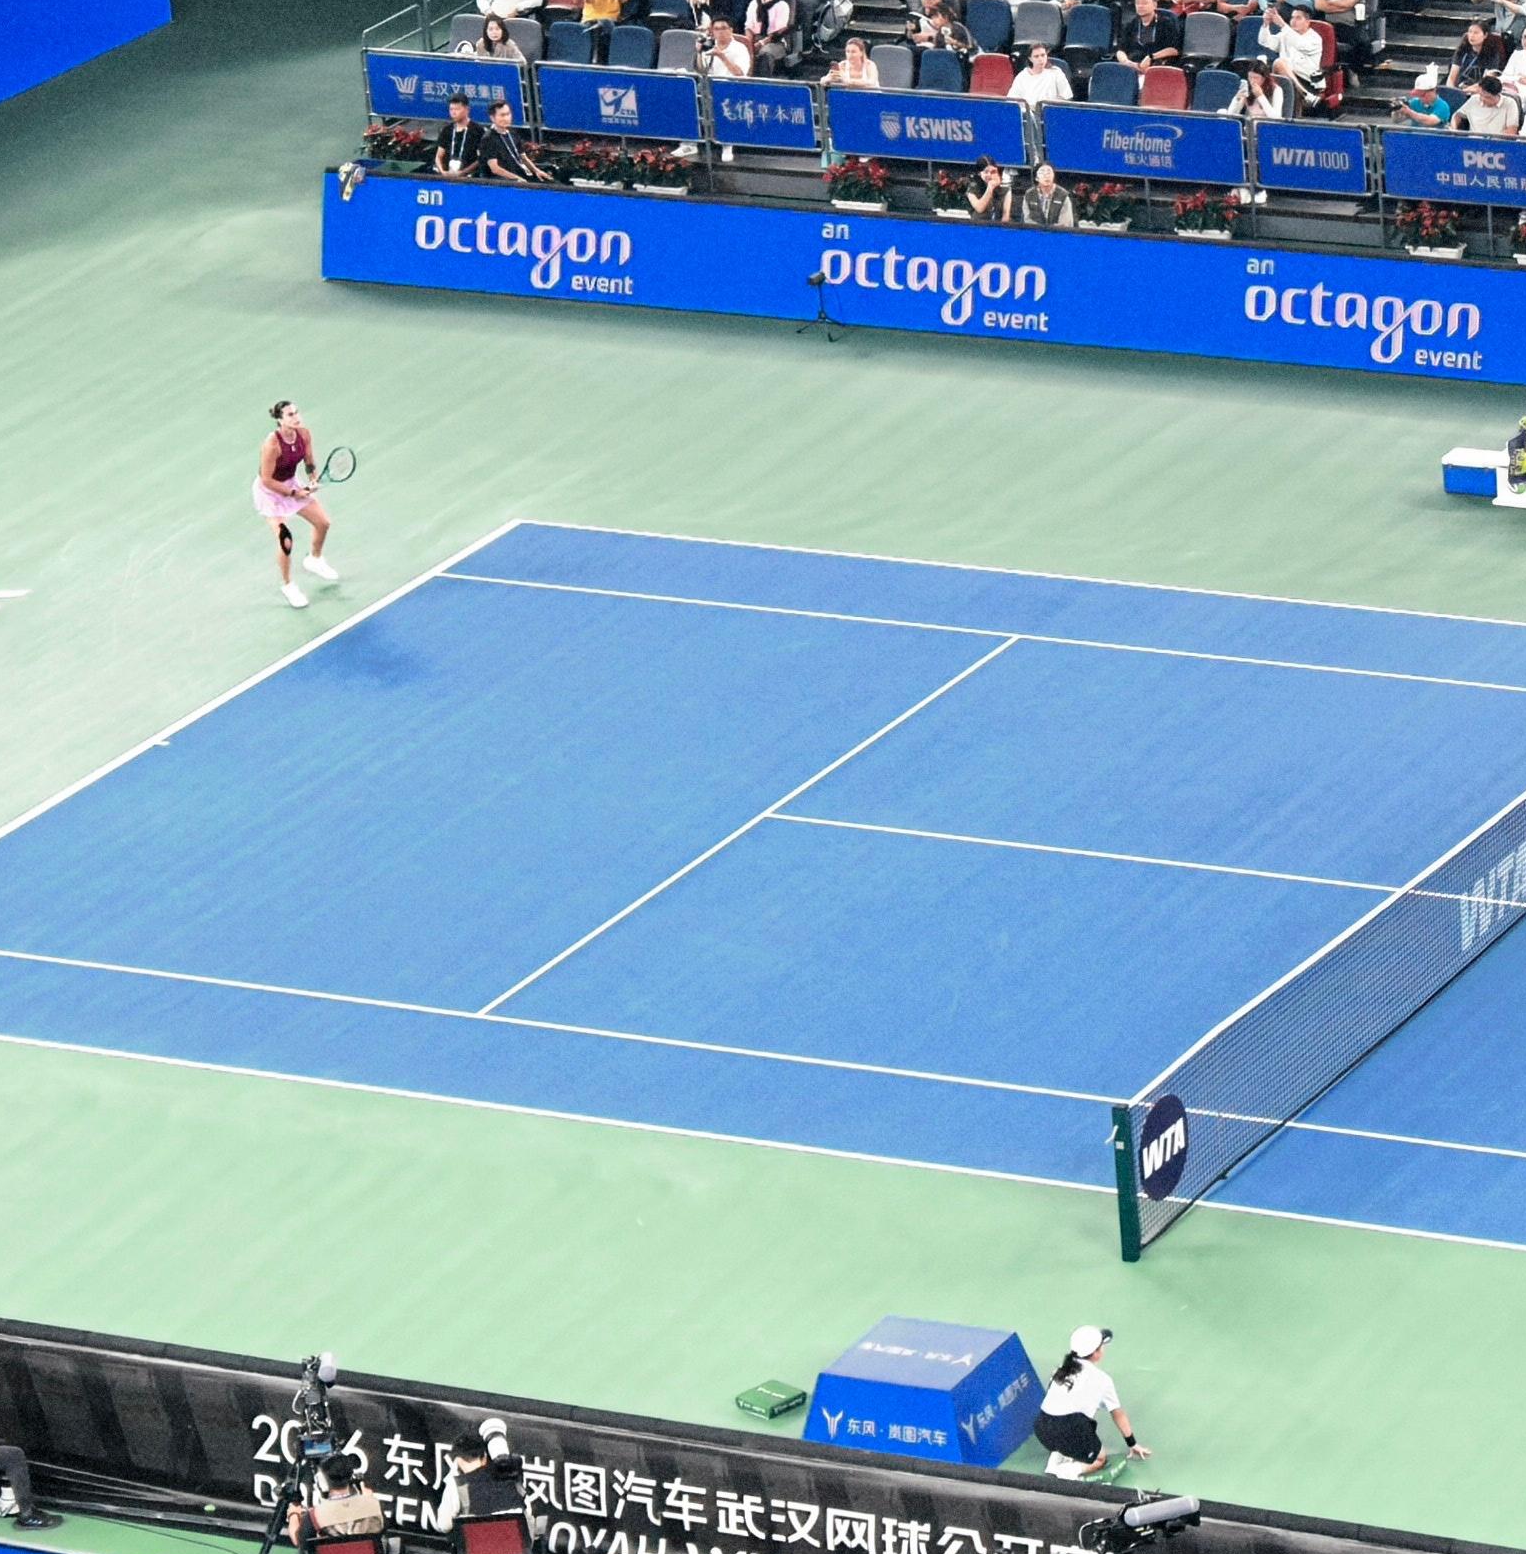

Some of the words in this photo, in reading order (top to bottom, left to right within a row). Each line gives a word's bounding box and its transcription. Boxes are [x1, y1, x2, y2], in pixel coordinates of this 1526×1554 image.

[1102, 129, 1172, 153] FiberHome
[1463, 150, 1506, 171] PICC
[416, 187, 444, 206] an
[821, 222, 851, 240] an
[414, 210, 633, 289] octagon
[1245, 257, 1275, 274] an
[571, 273, 634, 295] event
[820, 245, 1047, 325] octagon
[983, 309, 1049, 332] event
[1243, 281, 1481, 364] octagon
[1414, 346, 1482, 371] event
[1142, 1117, 1186, 1181] WTA
